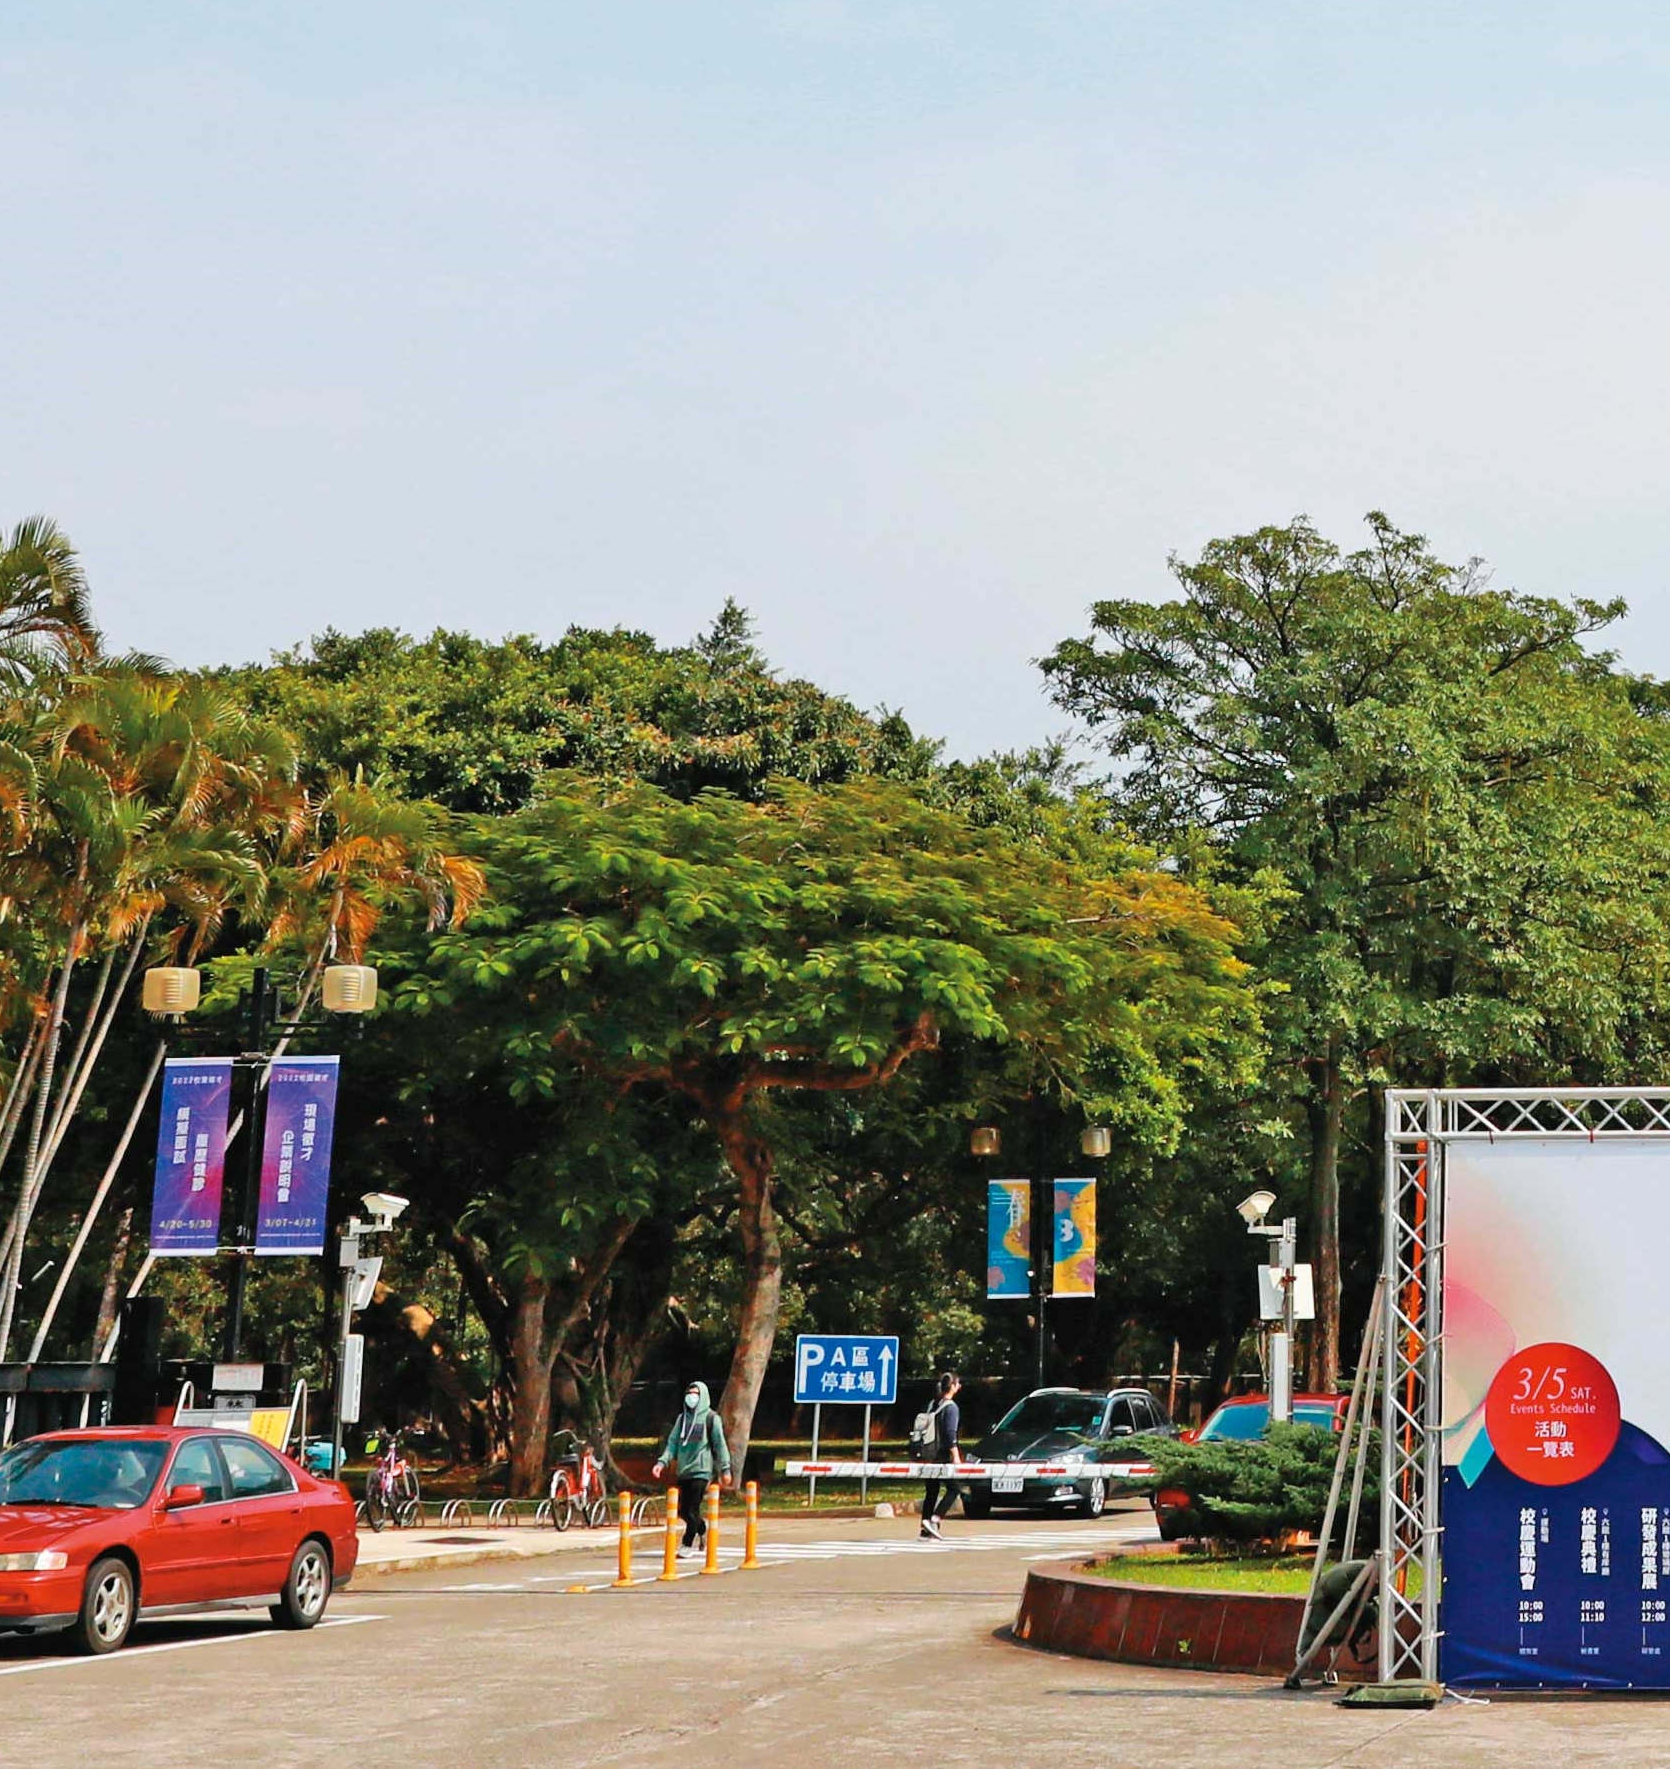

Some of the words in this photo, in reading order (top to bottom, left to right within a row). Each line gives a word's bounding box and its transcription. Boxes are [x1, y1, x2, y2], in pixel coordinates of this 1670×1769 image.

[300, 1103, 317, 1161] 現場徵才
[277, 1130, 295, 1203] 企業說明會
[798, 1344, 825, 1393] P
[820, 1371, 875, 1393] 停車場
[1513, 1366, 1567, 1400] 3/5
[1571, 1387, 1596, 1399] SAT.
[1510, 1403, 1544, 1414] Events
[1550, 1403, 1596, 1414] Schedule
[1534, 1421, 1567, 1438] 活動
[1526, 1441, 1575, 1458] 一覽表
[1519, 1507, 1536, 1590] 校慶運動會
[1581, 1507, 1597, 1574] 校慶典禮
[1641, 1507, 1658, 1590] 研發成果展
[1519, 1601, 1543, 1610] 10:00
[1580, 1601, 1605, 1610] 10:00
[1641, 1601, 1665, 1610] 10:00
[1519, 1612, 1543, 1622] 15:00
[1580, 1612, 1605, 1622] 11:10
[1641, 1612, 1665, 1622] 12:00
